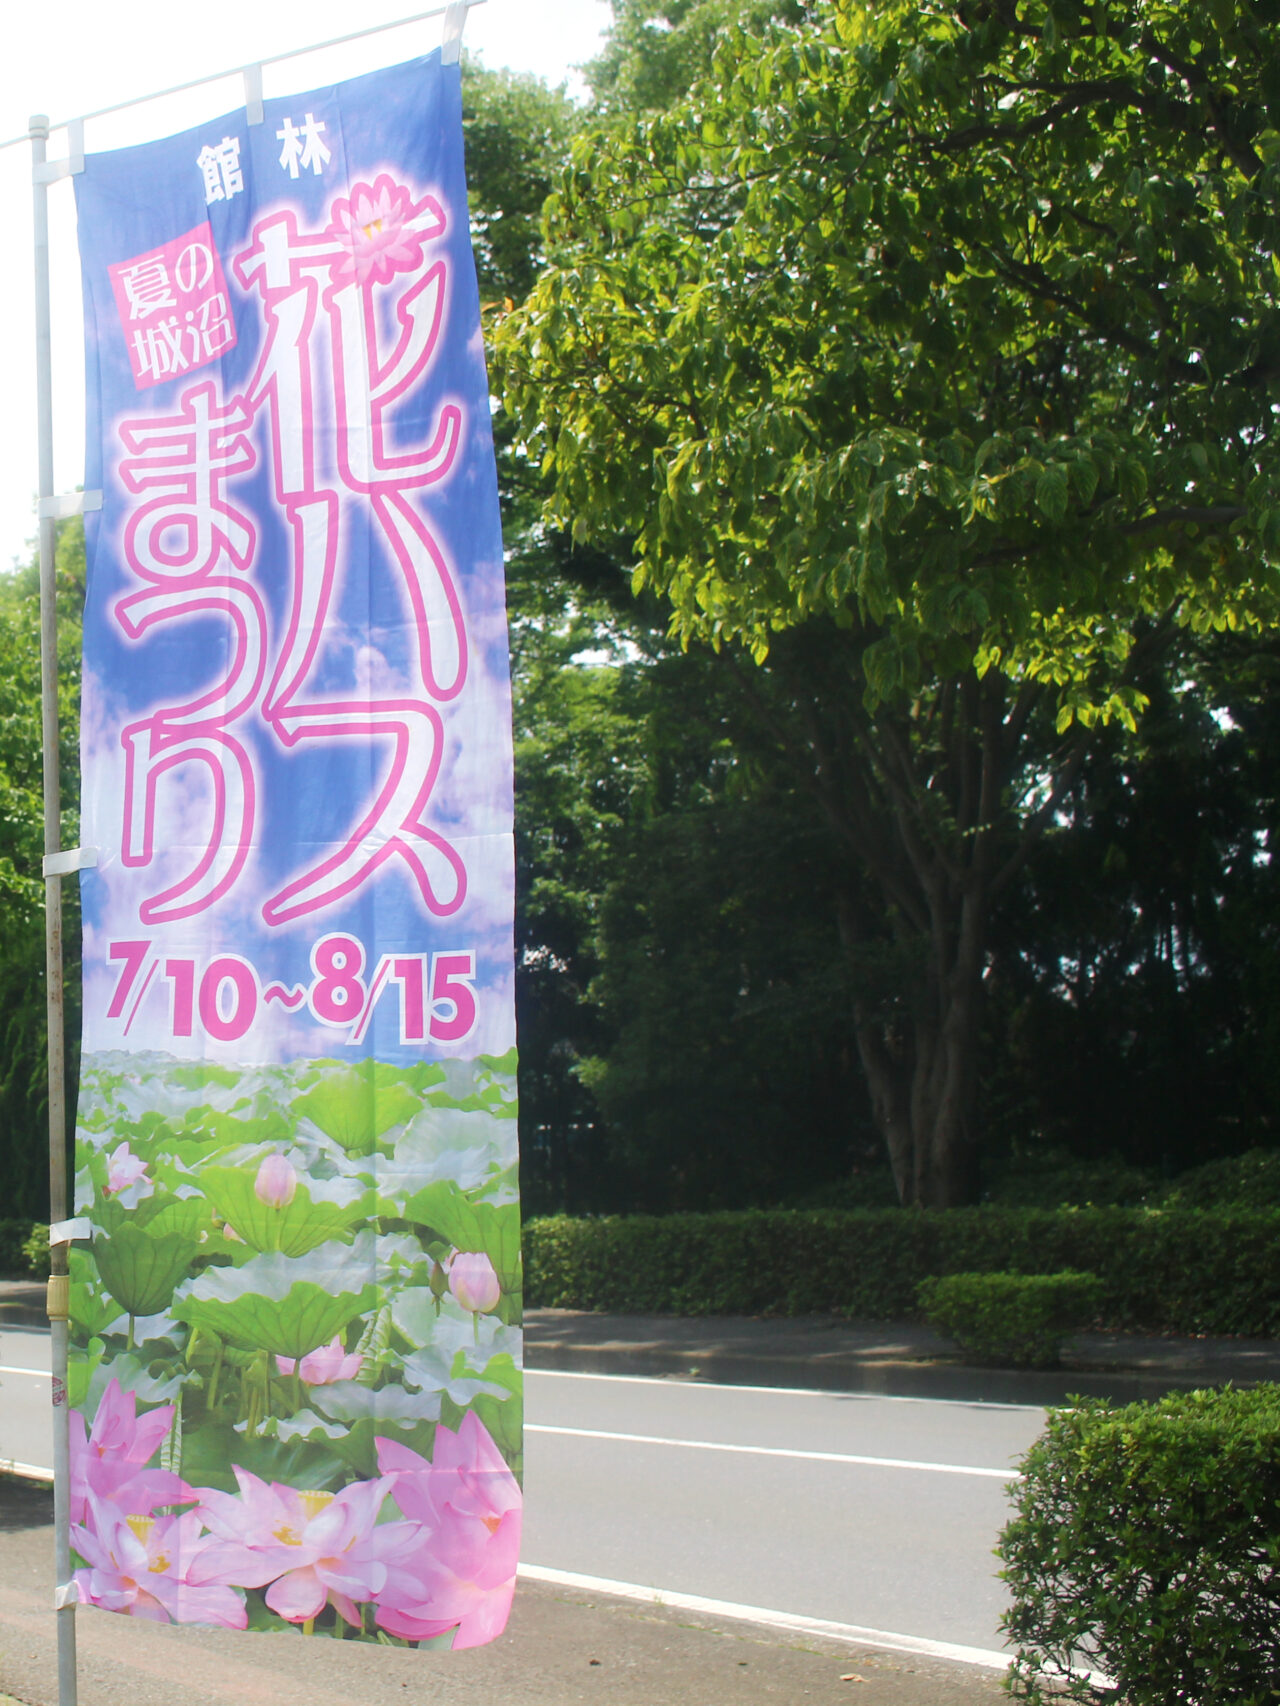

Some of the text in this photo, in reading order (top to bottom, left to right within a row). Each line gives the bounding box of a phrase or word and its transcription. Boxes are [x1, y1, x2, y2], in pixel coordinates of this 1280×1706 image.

[196, 113, 332, 205] 館林
[119, 243, 214, 320] 夏の
[131, 292, 233, 381] 城沼
[234, 173, 468, 926] 花ハス
[115, 381, 265, 925] まつり
